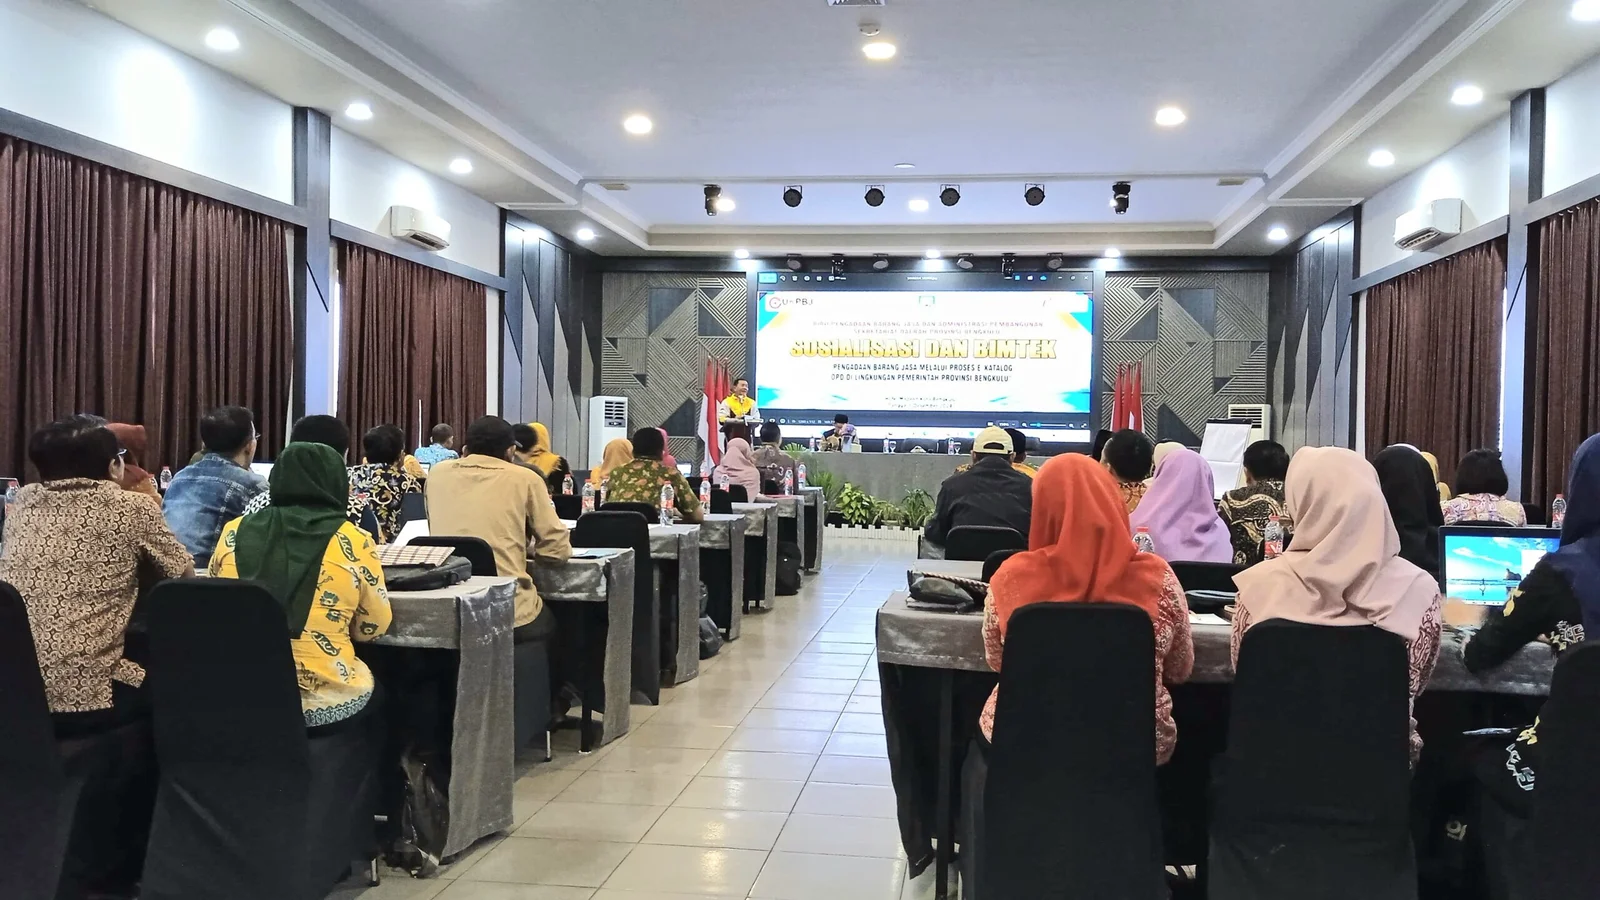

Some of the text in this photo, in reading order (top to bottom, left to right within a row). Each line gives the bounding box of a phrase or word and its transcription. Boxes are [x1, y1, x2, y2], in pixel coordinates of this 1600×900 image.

[789, 338, 1057, 359] SOSIALISASI DAN BIMTEK
[833, 363, 871, 371] PENGADAAN
[873, 363, 899, 371] BARANG
[901, 363, 917, 371] JASA
[949, 364, 975, 372] PROSES
[846, 373, 853, 381] DI
[855, 373, 895, 381] LINGKUNGAN
[897, 373, 939, 381] PEMERINTAH
[941, 374, 973, 382] PROVINSI
